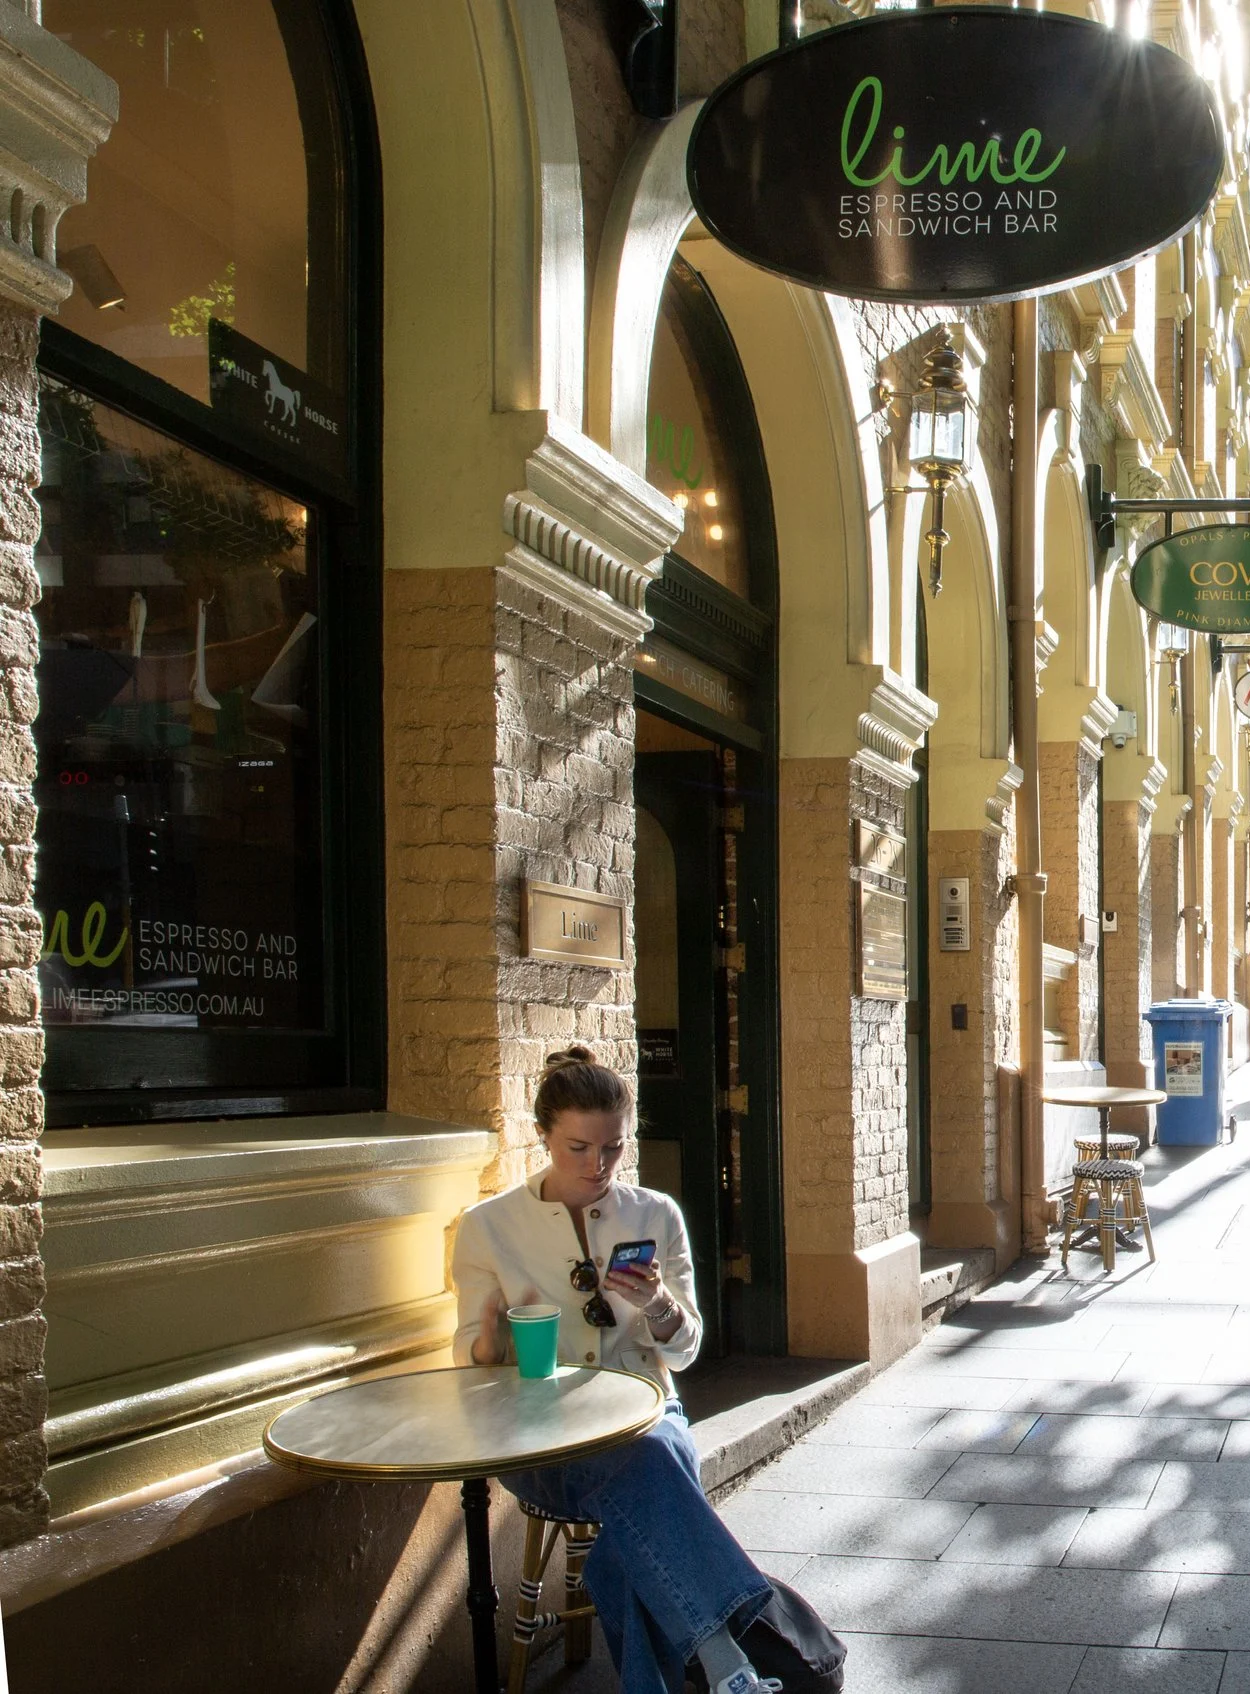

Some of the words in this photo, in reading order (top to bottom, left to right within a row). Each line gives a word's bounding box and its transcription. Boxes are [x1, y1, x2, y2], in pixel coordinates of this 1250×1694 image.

[841, 76, 1066, 187] lime
[840, 191, 982, 215] ESPRESSO
[995, 189, 1057, 210] AND
[838, 215, 991, 238] SANDWICH
[1005, 213, 1058, 234] BAR
[304, 406, 339, 435] HORSE
[1179, 531, 1224, 547] OPALS
[1176, 609, 1210, 625] PINK
[682, 667, 735, 716] CATERING
[139, 919, 249, 951] ESPRESSO
[256, 933, 297, 956] AND
[562, 911, 598, 942] Lime
[139, 948, 256, 978] SANDWICH
[263, 958, 298, 981] BAR
